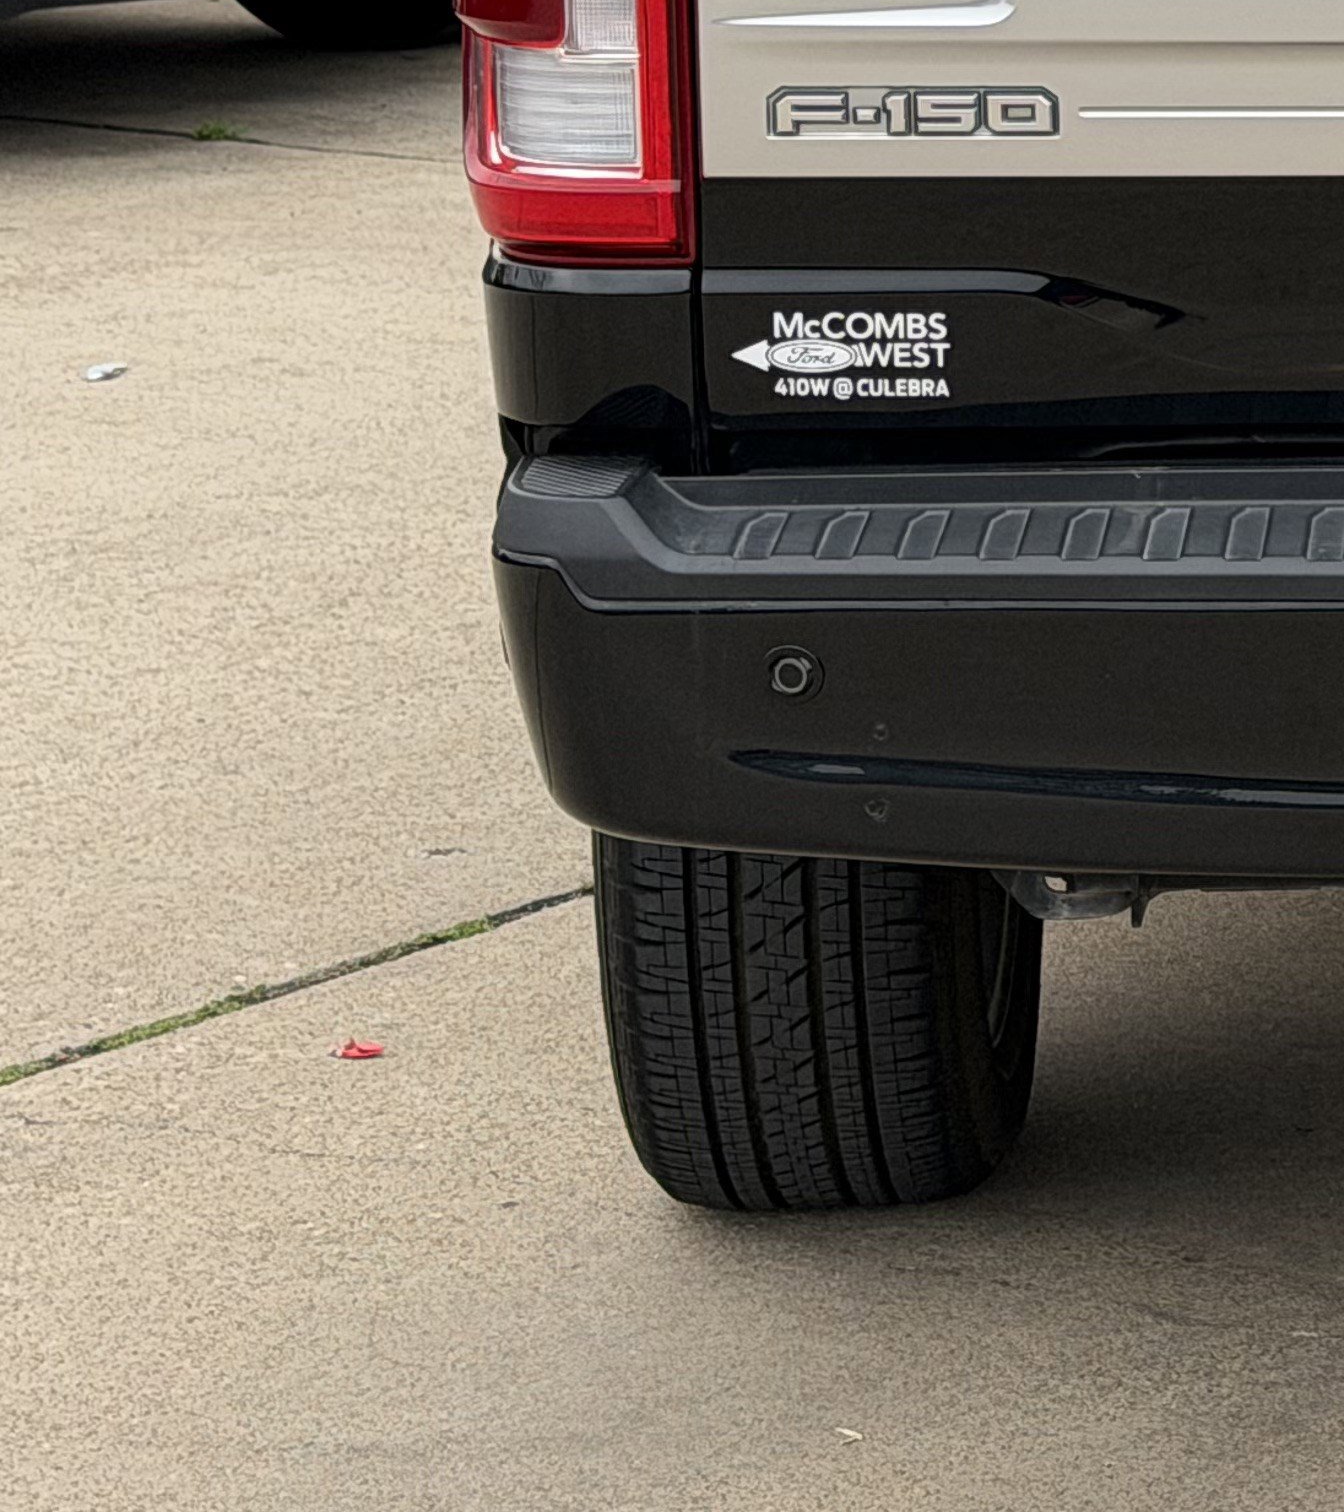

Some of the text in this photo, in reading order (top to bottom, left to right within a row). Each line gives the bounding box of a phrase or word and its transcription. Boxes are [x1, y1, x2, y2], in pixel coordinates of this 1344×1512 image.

[766, 85, 1060, 140] F-150
[773, 311, 948, 340] McCOMBS
[787, 342, 951, 368] Ford WEST
